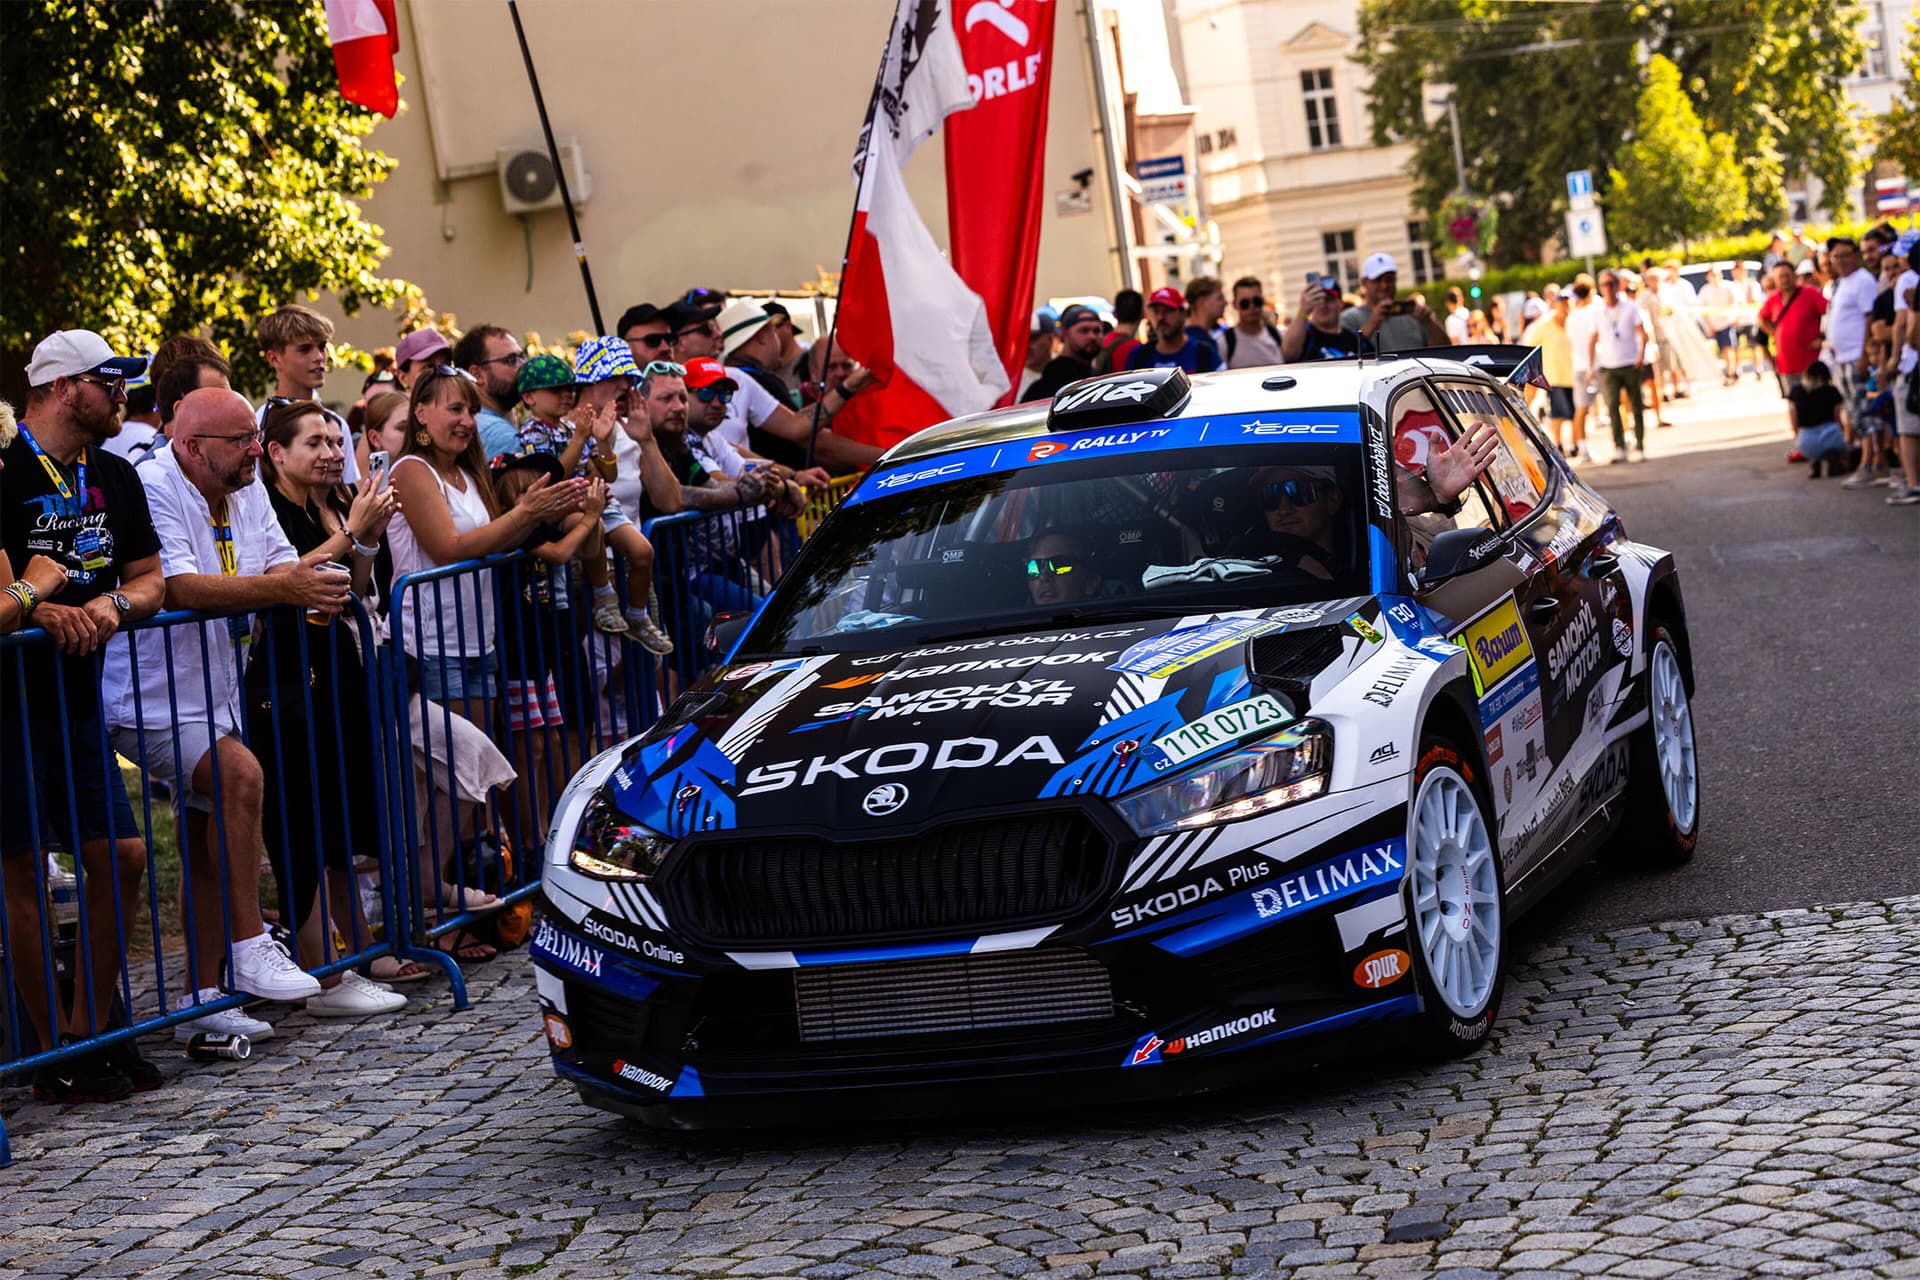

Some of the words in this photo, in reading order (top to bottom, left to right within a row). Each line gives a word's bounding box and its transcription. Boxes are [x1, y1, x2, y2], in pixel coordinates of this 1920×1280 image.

[967, 50, 1042, 101] ORLE
[57, 541, 63, 552] 2
[942, 551, 965, 562] OMP
[1388, 603, 1416, 624] 130
[1475, 621, 1524, 668] Barum
[1565, 632, 1601, 700] MOTOR
[1362, 655, 1427, 708] DELIMAX
[868, 692, 1073, 720] MOTOR
[1164, 722, 1220, 756] 11R
[1214, 699, 1282, 735] 0723
[1153, 756, 1173, 771] CZ
[1370, 740, 1400, 759] ACL
[1227, 861, 1270, 887] Plus
[1251, 844, 1403, 918] DELIMAX
[534, 918, 604, 977] DELIMAX
[642, 940, 685, 965] Online
